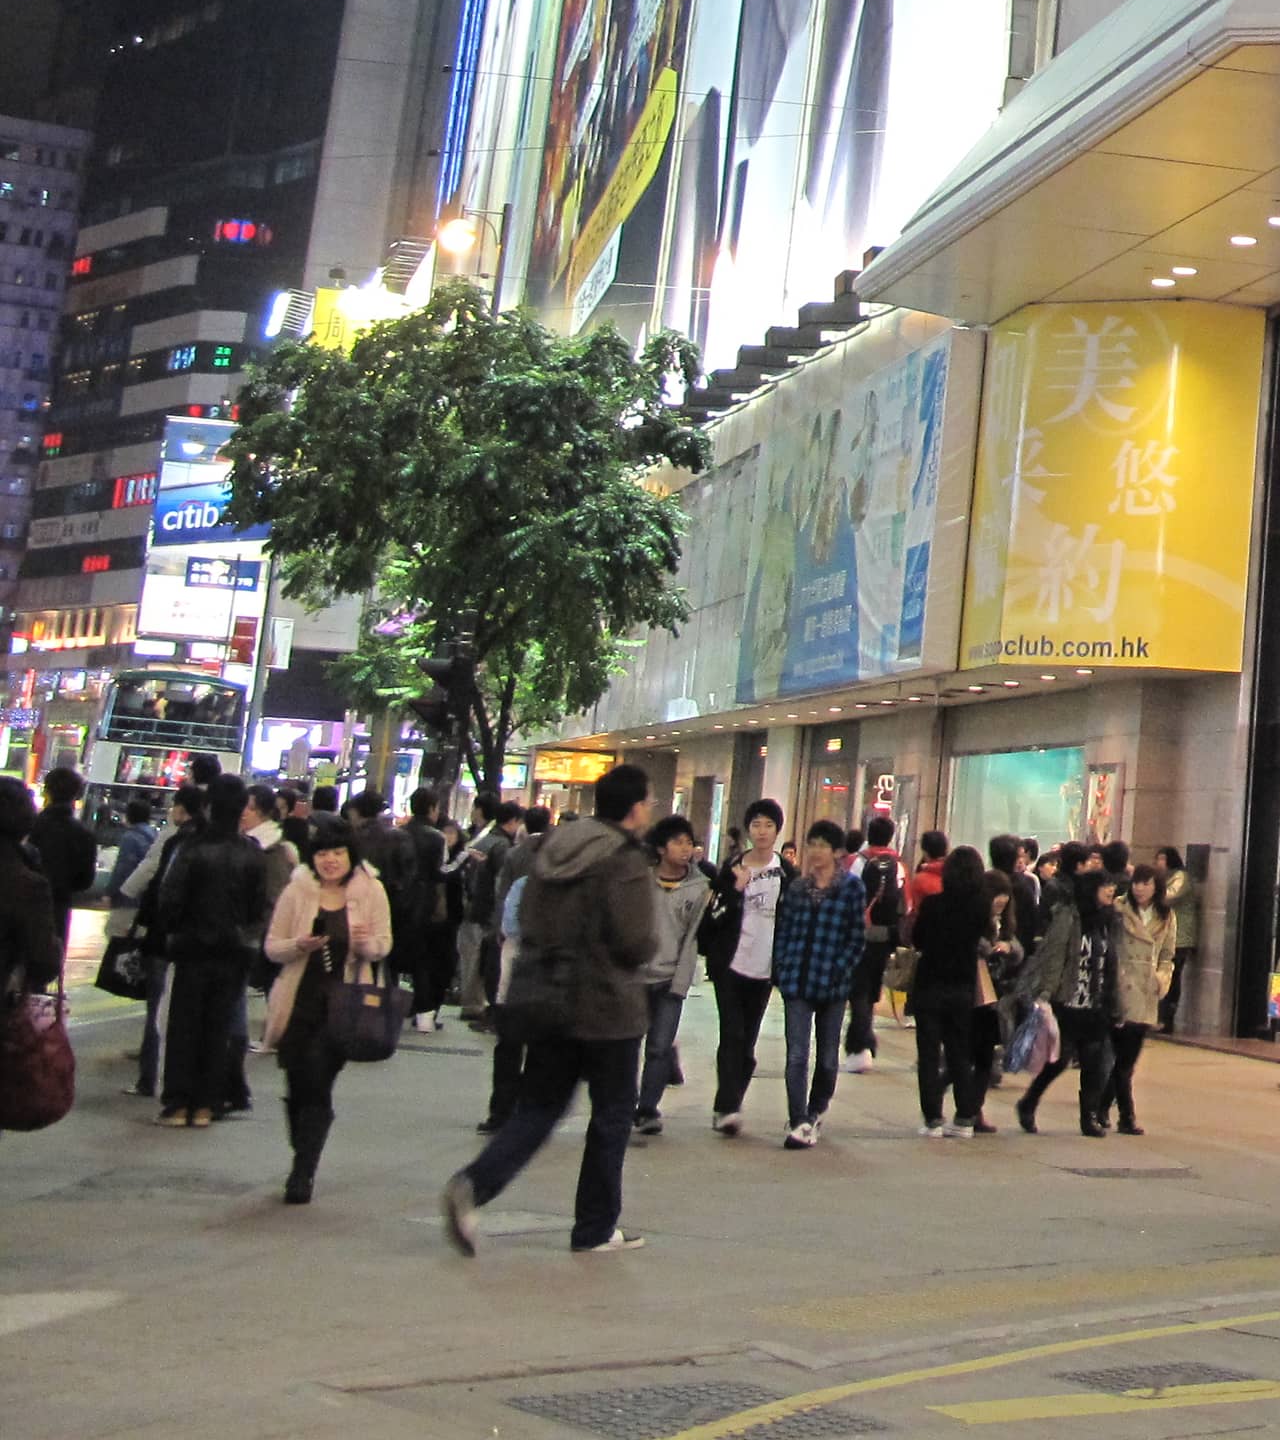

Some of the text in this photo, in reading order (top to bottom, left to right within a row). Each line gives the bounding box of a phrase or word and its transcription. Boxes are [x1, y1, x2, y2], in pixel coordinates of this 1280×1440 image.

[1042, 315, 1140, 424] 美
[1106, 438, 1181, 515] 悠
[1036, 522, 1126, 623] 約
